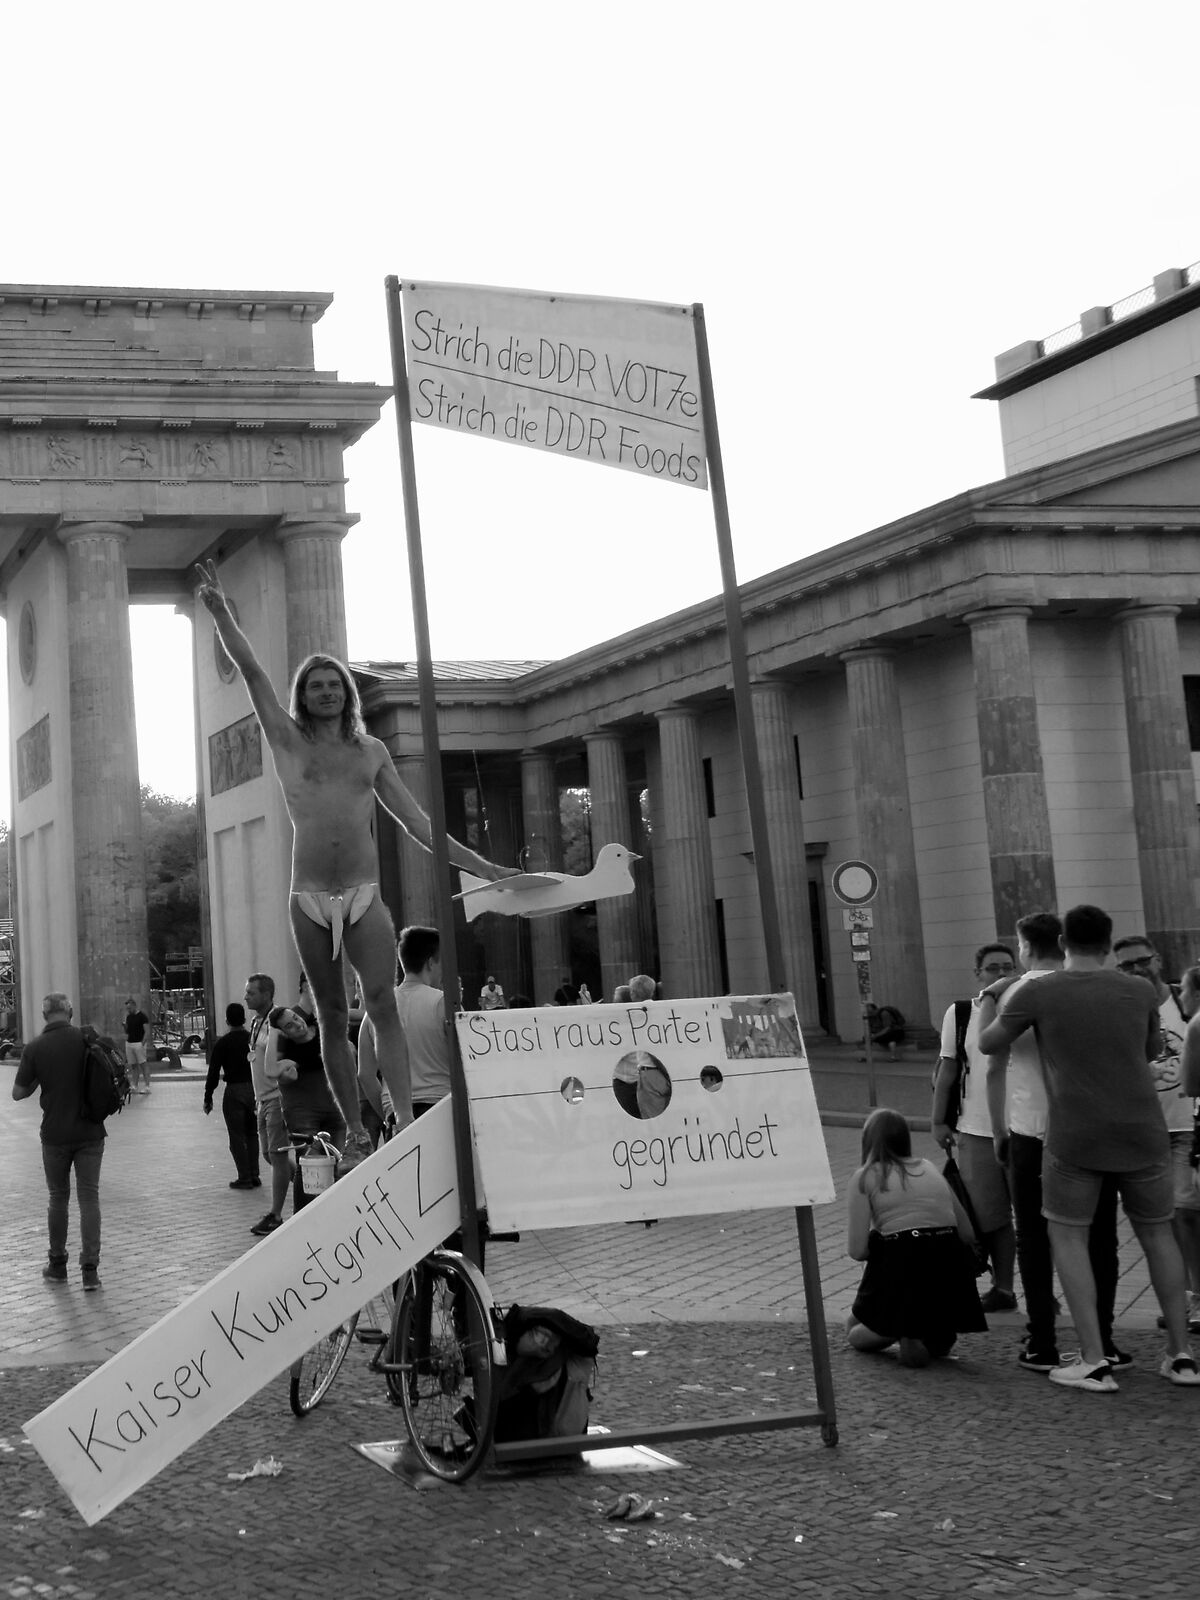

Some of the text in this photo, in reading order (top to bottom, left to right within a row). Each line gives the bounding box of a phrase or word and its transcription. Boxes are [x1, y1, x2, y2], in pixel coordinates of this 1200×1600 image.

[411, 309, 490, 367] Strich
[497, 335, 533, 376] die
[538, 338, 597, 392] DDR
[415, 378, 701, 482] Strich die DDR Foods
[553, 1021, 623, 1050] raus
[612, 1113, 779, 1190] gegründet
[67, 1349, 213, 1474] Kaiser
[210, 1176, 415, 1361] Kunstgriff
